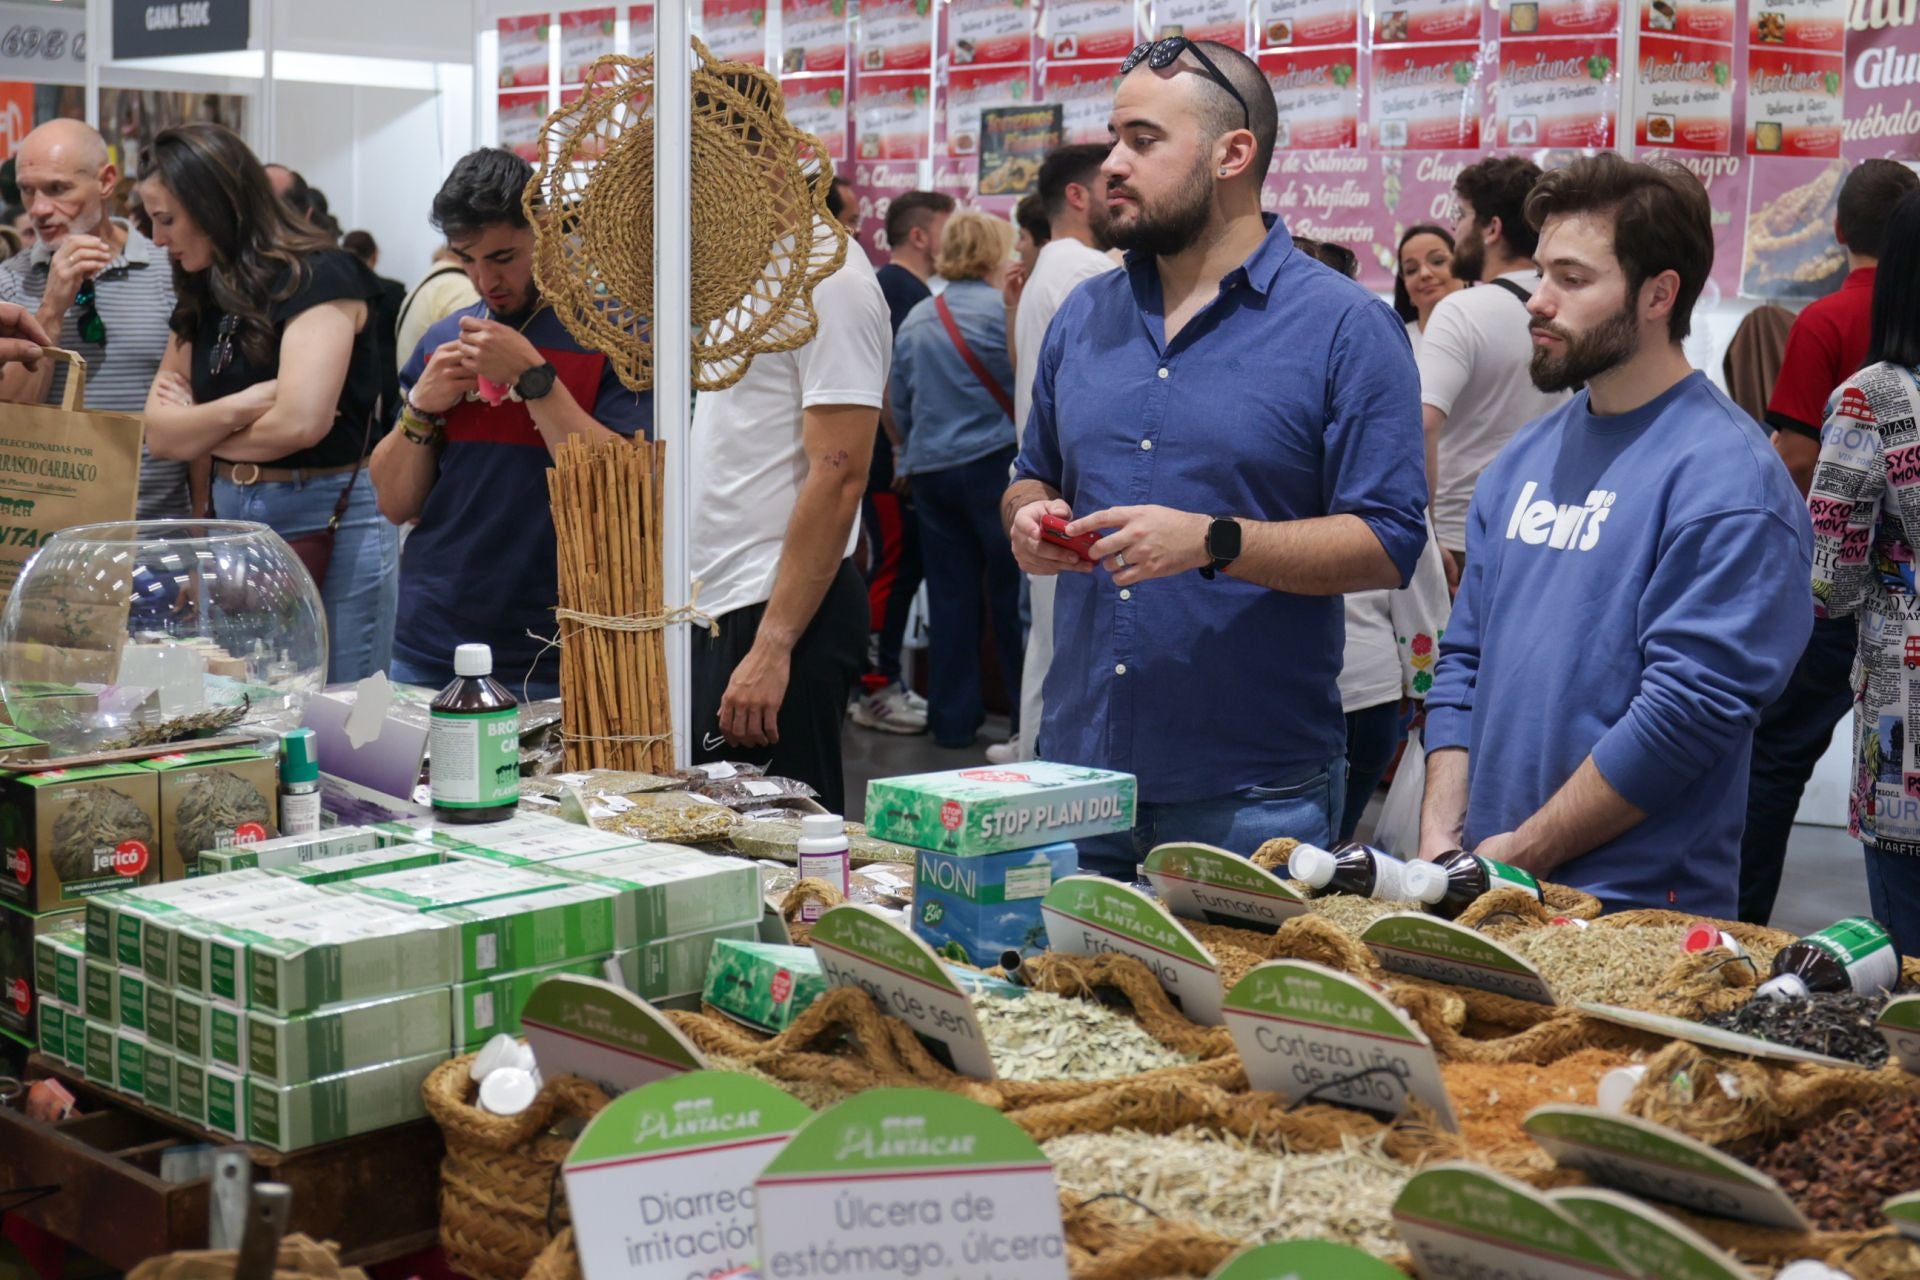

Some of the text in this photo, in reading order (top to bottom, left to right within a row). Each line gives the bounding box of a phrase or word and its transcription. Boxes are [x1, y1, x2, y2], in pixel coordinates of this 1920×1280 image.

[146, 5, 178, 31] GANA
[1641, 52, 1711, 84] Aceitunas
[1302, 150, 1368, 174] Salmón
[74, 447, 94, 456] POR
[40, 458, 97, 482] CARRASCO
[1810, 501, 1853, 519] PSYCO
[980, 795, 1122, 839] STOP PLAN DOL
[921, 855, 977, 898] NONI
[924, 903, 943, 922] Bio
[1192, 889, 1276, 919] Fumaria
[891, 987, 926, 1021] de
[929, 1004, 974, 1039] sen
[1255, 1026, 1355, 1068] Corteza
[1292, 1060, 1325, 1085] de
[834, 1189, 995, 1231] Úlcera de
[771, 1238, 954, 1277] estómago,
[961, 1228, 1063, 1265] úlcera
